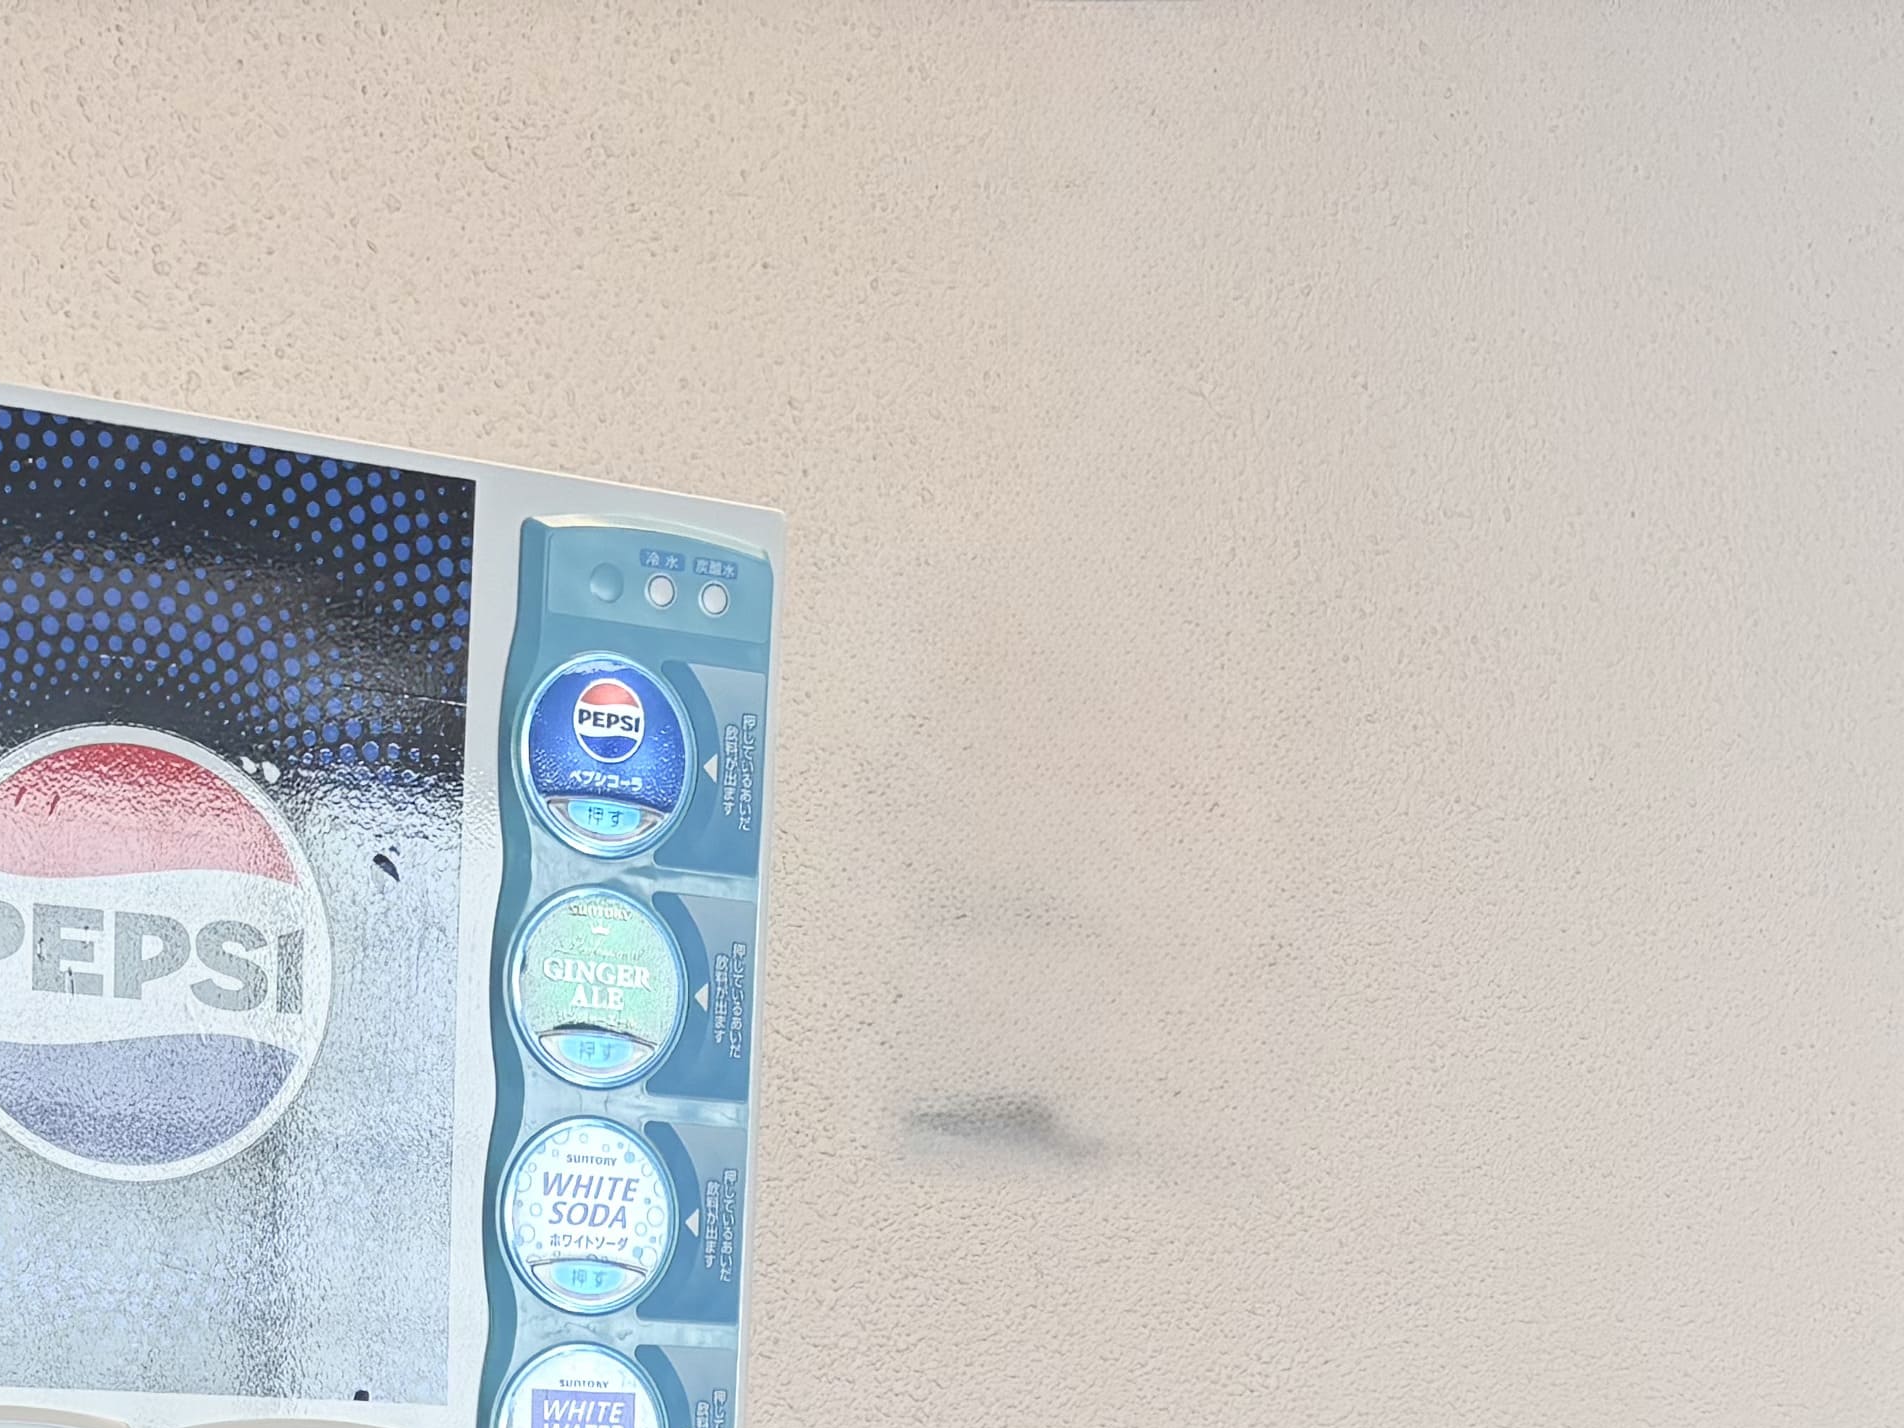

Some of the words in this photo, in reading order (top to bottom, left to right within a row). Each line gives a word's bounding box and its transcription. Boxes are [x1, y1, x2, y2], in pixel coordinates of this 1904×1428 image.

[578, 708, 640, 734] PEPSI
[570, 770, 643, 792] ペプシコーラ
[588, 807, 625, 828] 押す
[543, 956, 652, 993] GINGER
[570, 983, 626, 1012] ALE
[566, 1154, 617, 1167] SUNTORY
[543, 1171, 640, 1202] WHITE
[548, 1201, 627, 1230] SODA
[550, 1233, 629, 1250] ホワイトソーダ
[544, 1400, 625, 1424] WHITE
